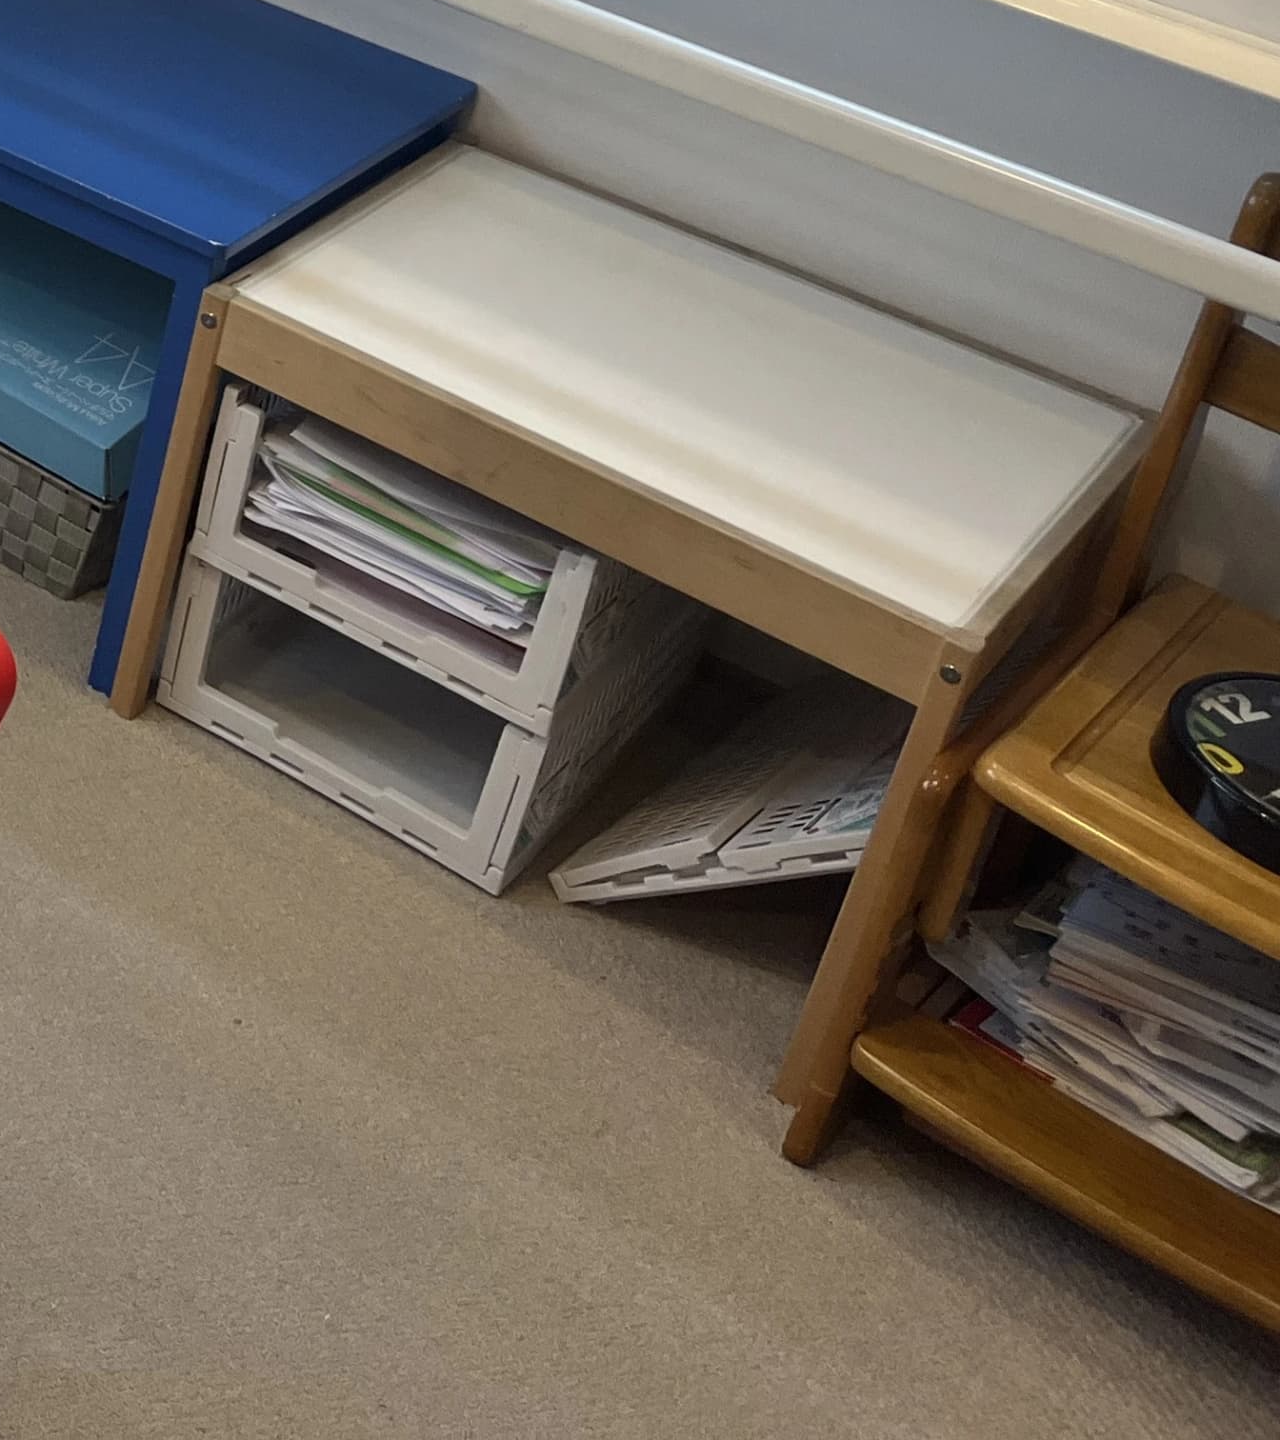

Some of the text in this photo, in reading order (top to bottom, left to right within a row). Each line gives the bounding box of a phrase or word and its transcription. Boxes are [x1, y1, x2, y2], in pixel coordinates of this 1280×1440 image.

[12, 340, 69, 379] White
[74, 333, 157, 391] A4
[69, 373, 133, 413] Super
[1199, 692, 1273, 726] 12
[1197, 742, 1244, 776] 0
